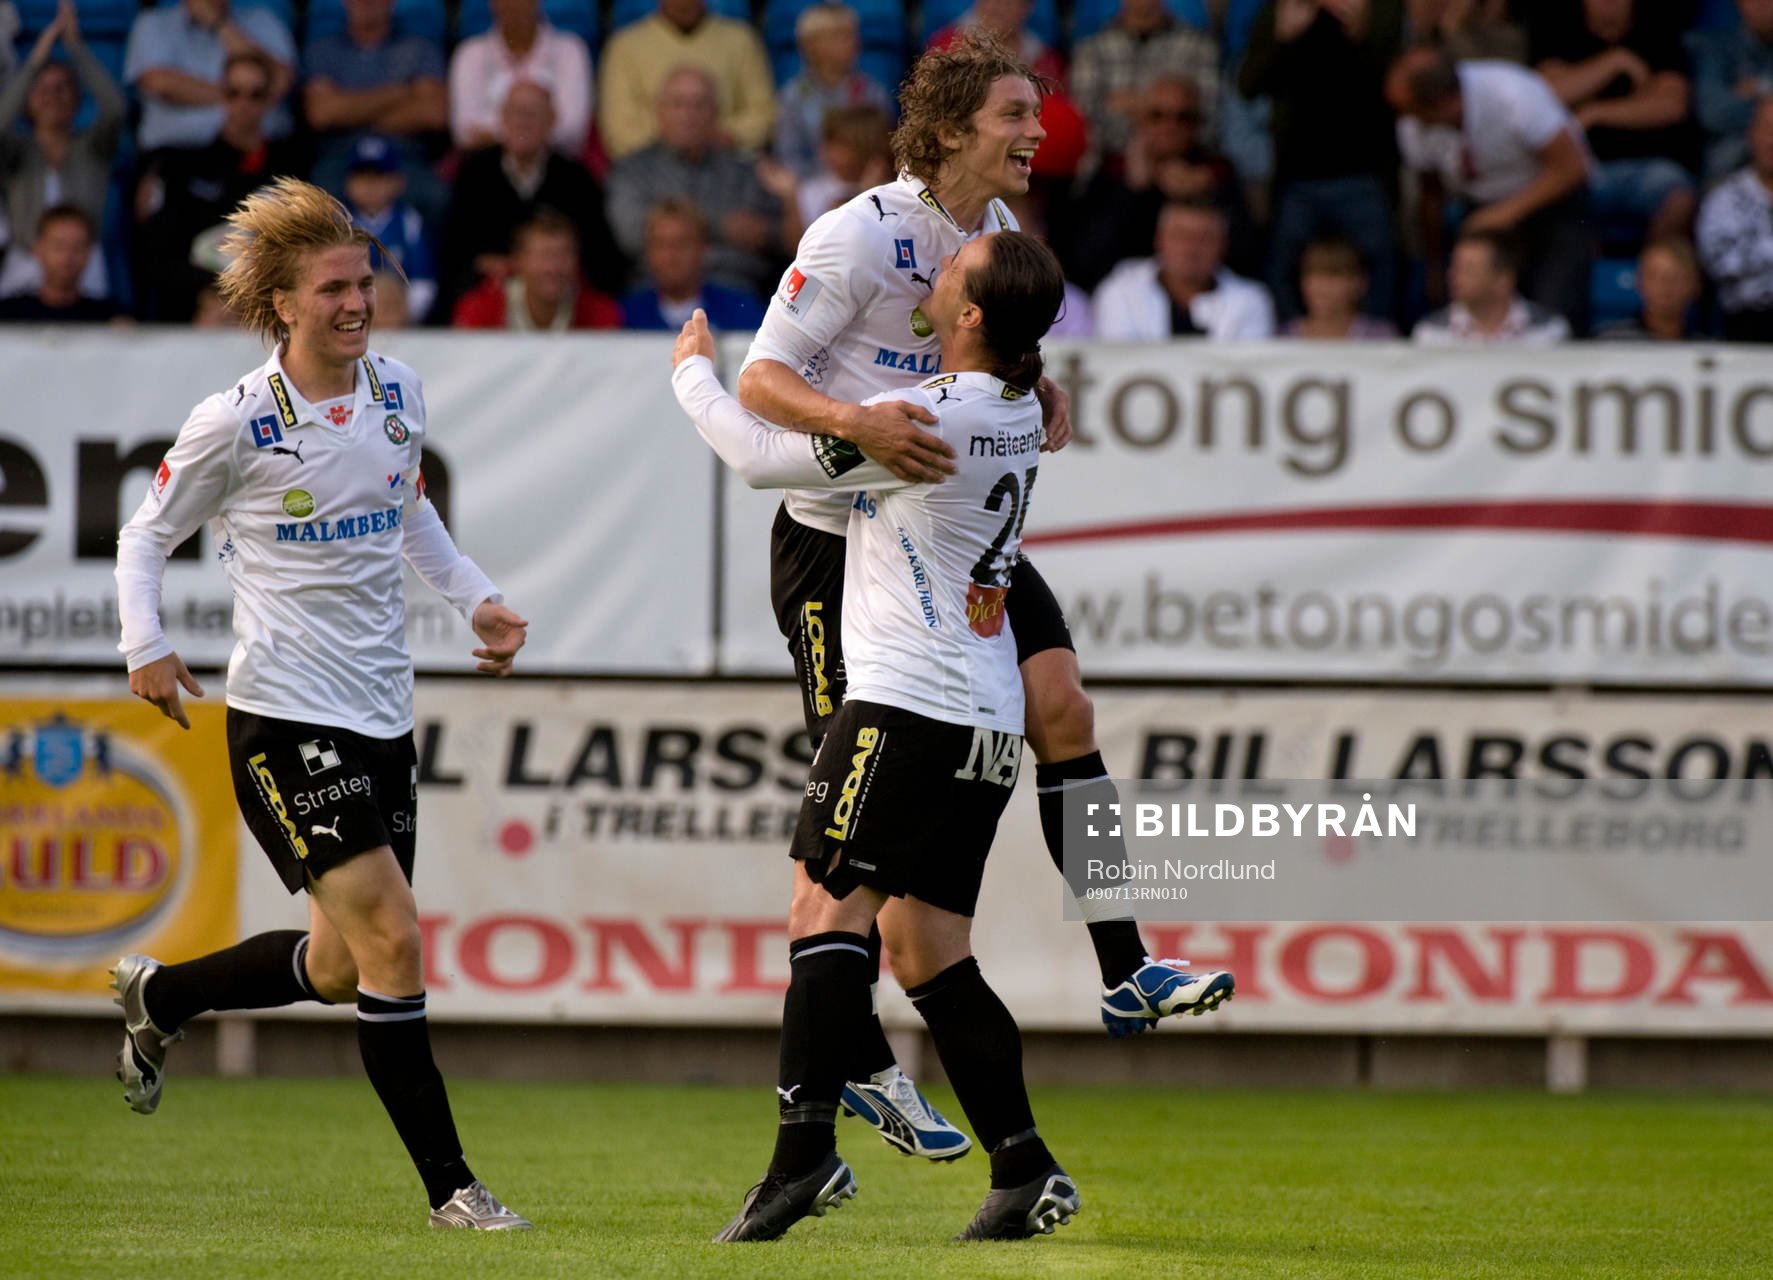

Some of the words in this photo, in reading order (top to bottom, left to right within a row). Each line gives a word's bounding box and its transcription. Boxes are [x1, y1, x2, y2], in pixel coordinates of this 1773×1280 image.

[1394, 395, 1457, 454] o
[908, 555, 926, 589] KARL
[918, 590, 938, 628] HEDIN
[805, 601, 833, 717] LODAB
[825, 727, 879, 841] LODAB
[1138, 730, 1284, 799] BIL
[248, 752, 309, 860] LODAB
[0, 836, 168, 891] ULD
